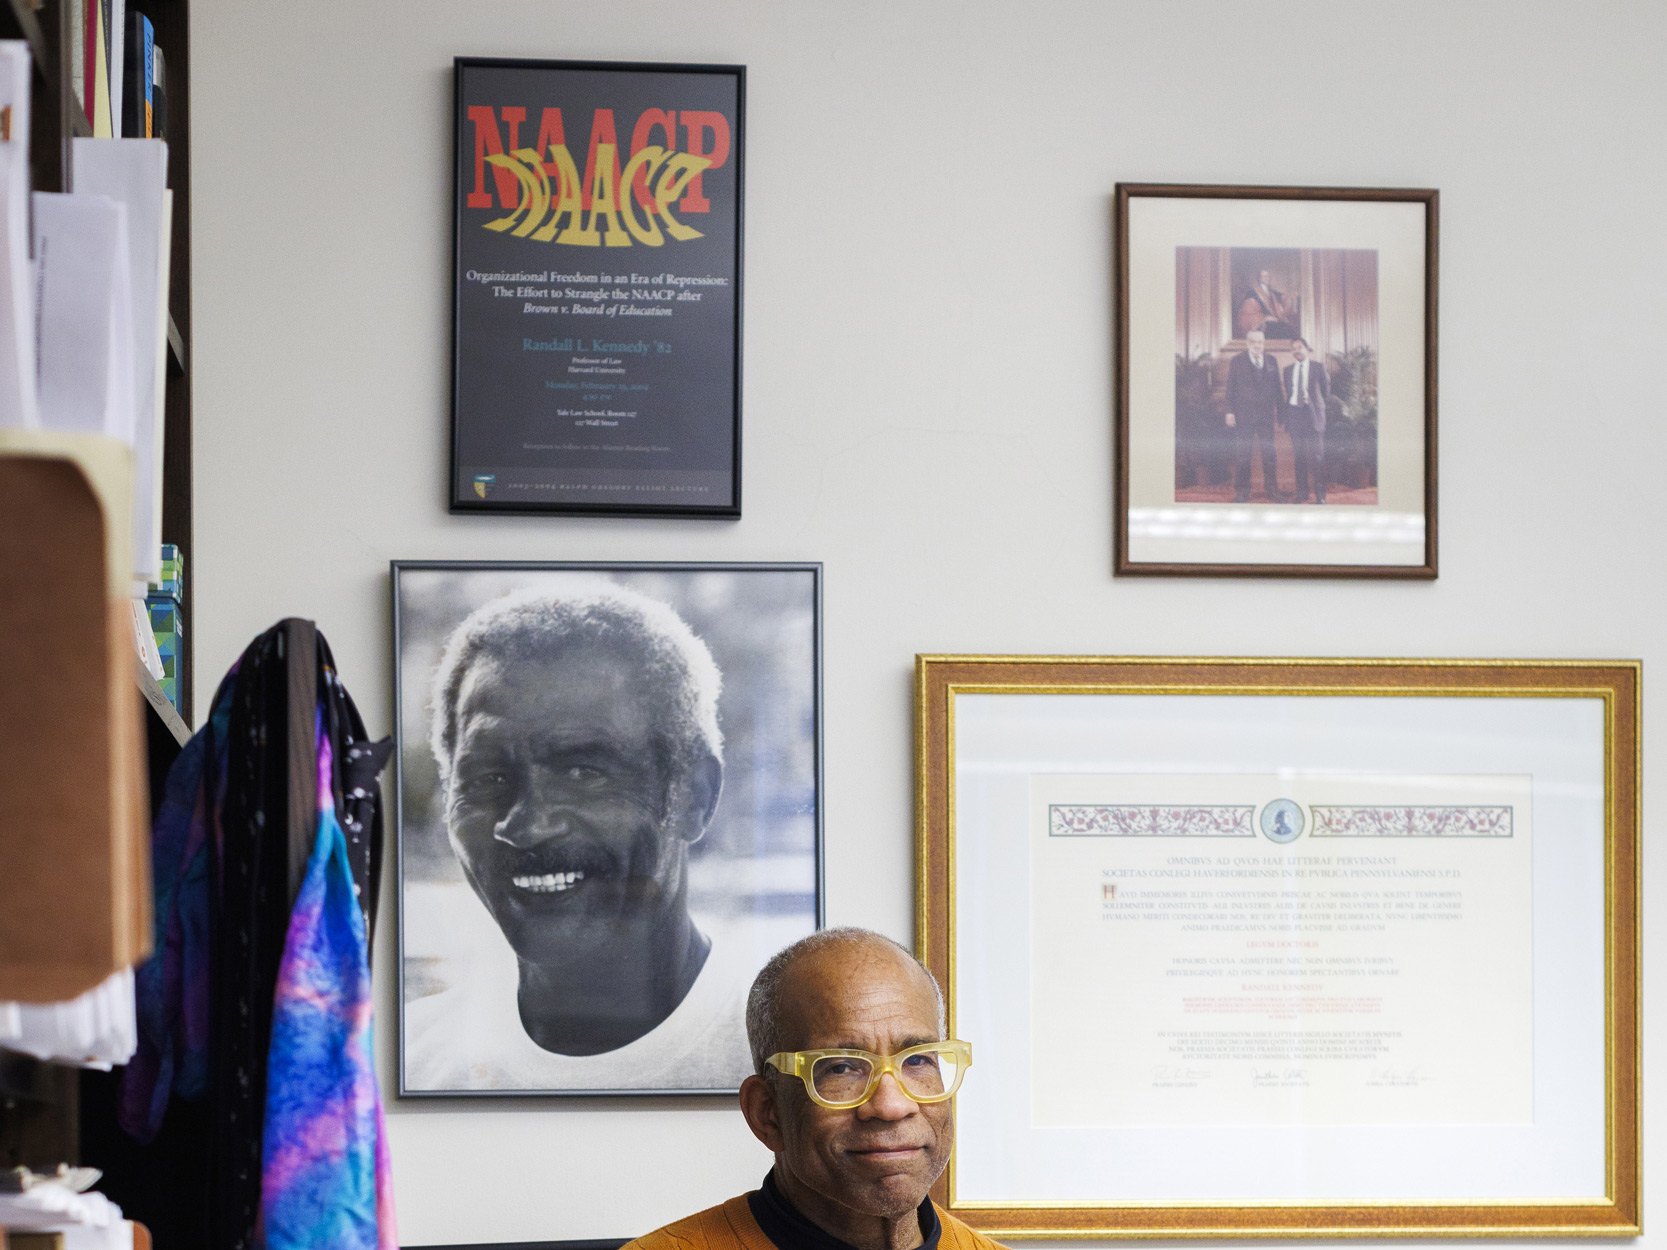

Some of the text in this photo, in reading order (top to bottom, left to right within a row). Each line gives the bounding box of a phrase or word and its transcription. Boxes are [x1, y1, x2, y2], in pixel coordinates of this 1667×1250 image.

[467, 105, 731, 213] NAACP
[482, 142, 712, 247] NAACP
[466, 270, 729, 287] Organizational Freedom in an Era of Repression:
[493, 286, 703, 302] The Effort to Strangle the NAACP after
[523, 303, 673, 318] Brown v. Board of Education
[522, 338, 573, 352] Randall
[592, 339, 650, 356] Kennedy
[1167, 857, 1396, 866] OMNIBVS AD QVOS HAE LITTERAE PERVENIANT
[1103, 869, 1147, 878] SOCIETAS
[1149, 869, 1190, 878] CONLEGI
[1192, 869, 1279, 878] HAVERFORDIENSIS
[1281, 869, 1292, 878] IN
[1295, 869, 1306, 878] RE
[1309, 869, 1347, 878] PVBLICA
[1439, 869, 1460, 878] S.P.D.
